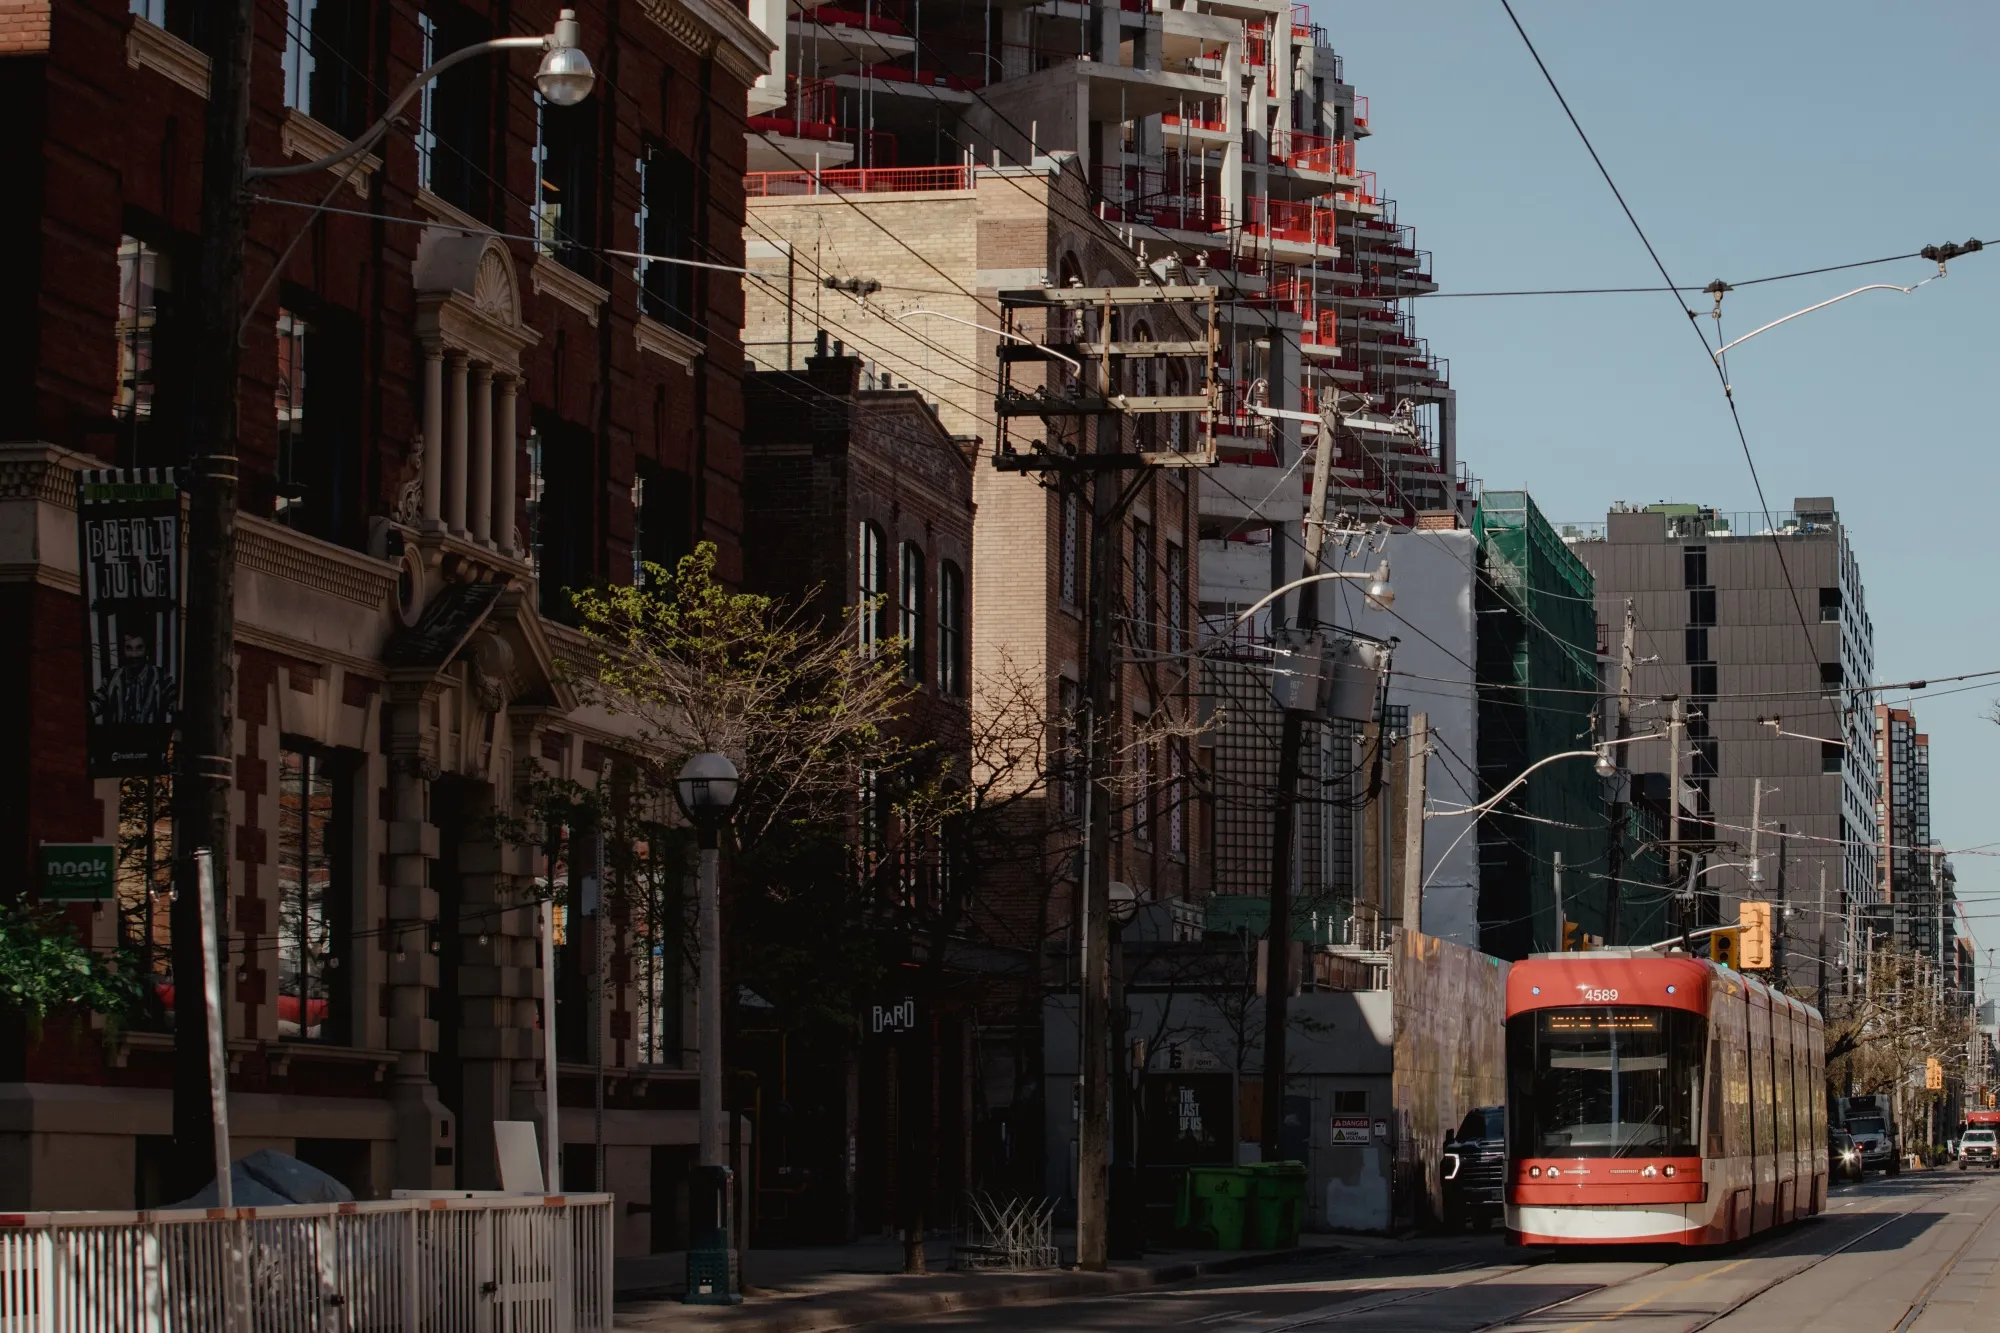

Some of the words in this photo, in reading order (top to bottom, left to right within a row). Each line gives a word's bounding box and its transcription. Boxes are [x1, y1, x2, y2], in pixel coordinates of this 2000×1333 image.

[91, 519, 172, 558] BEETLE
[47, 858, 108, 878] nook
[1585, 988, 1619, 1001] 4589
[1180, 1089, 1195, 1102] THE
[1179, 1102, 1200, 1117] LAST
[1179, 1116, 1190, 1131] OF
[1191, 1116, 1203, 1131] US
